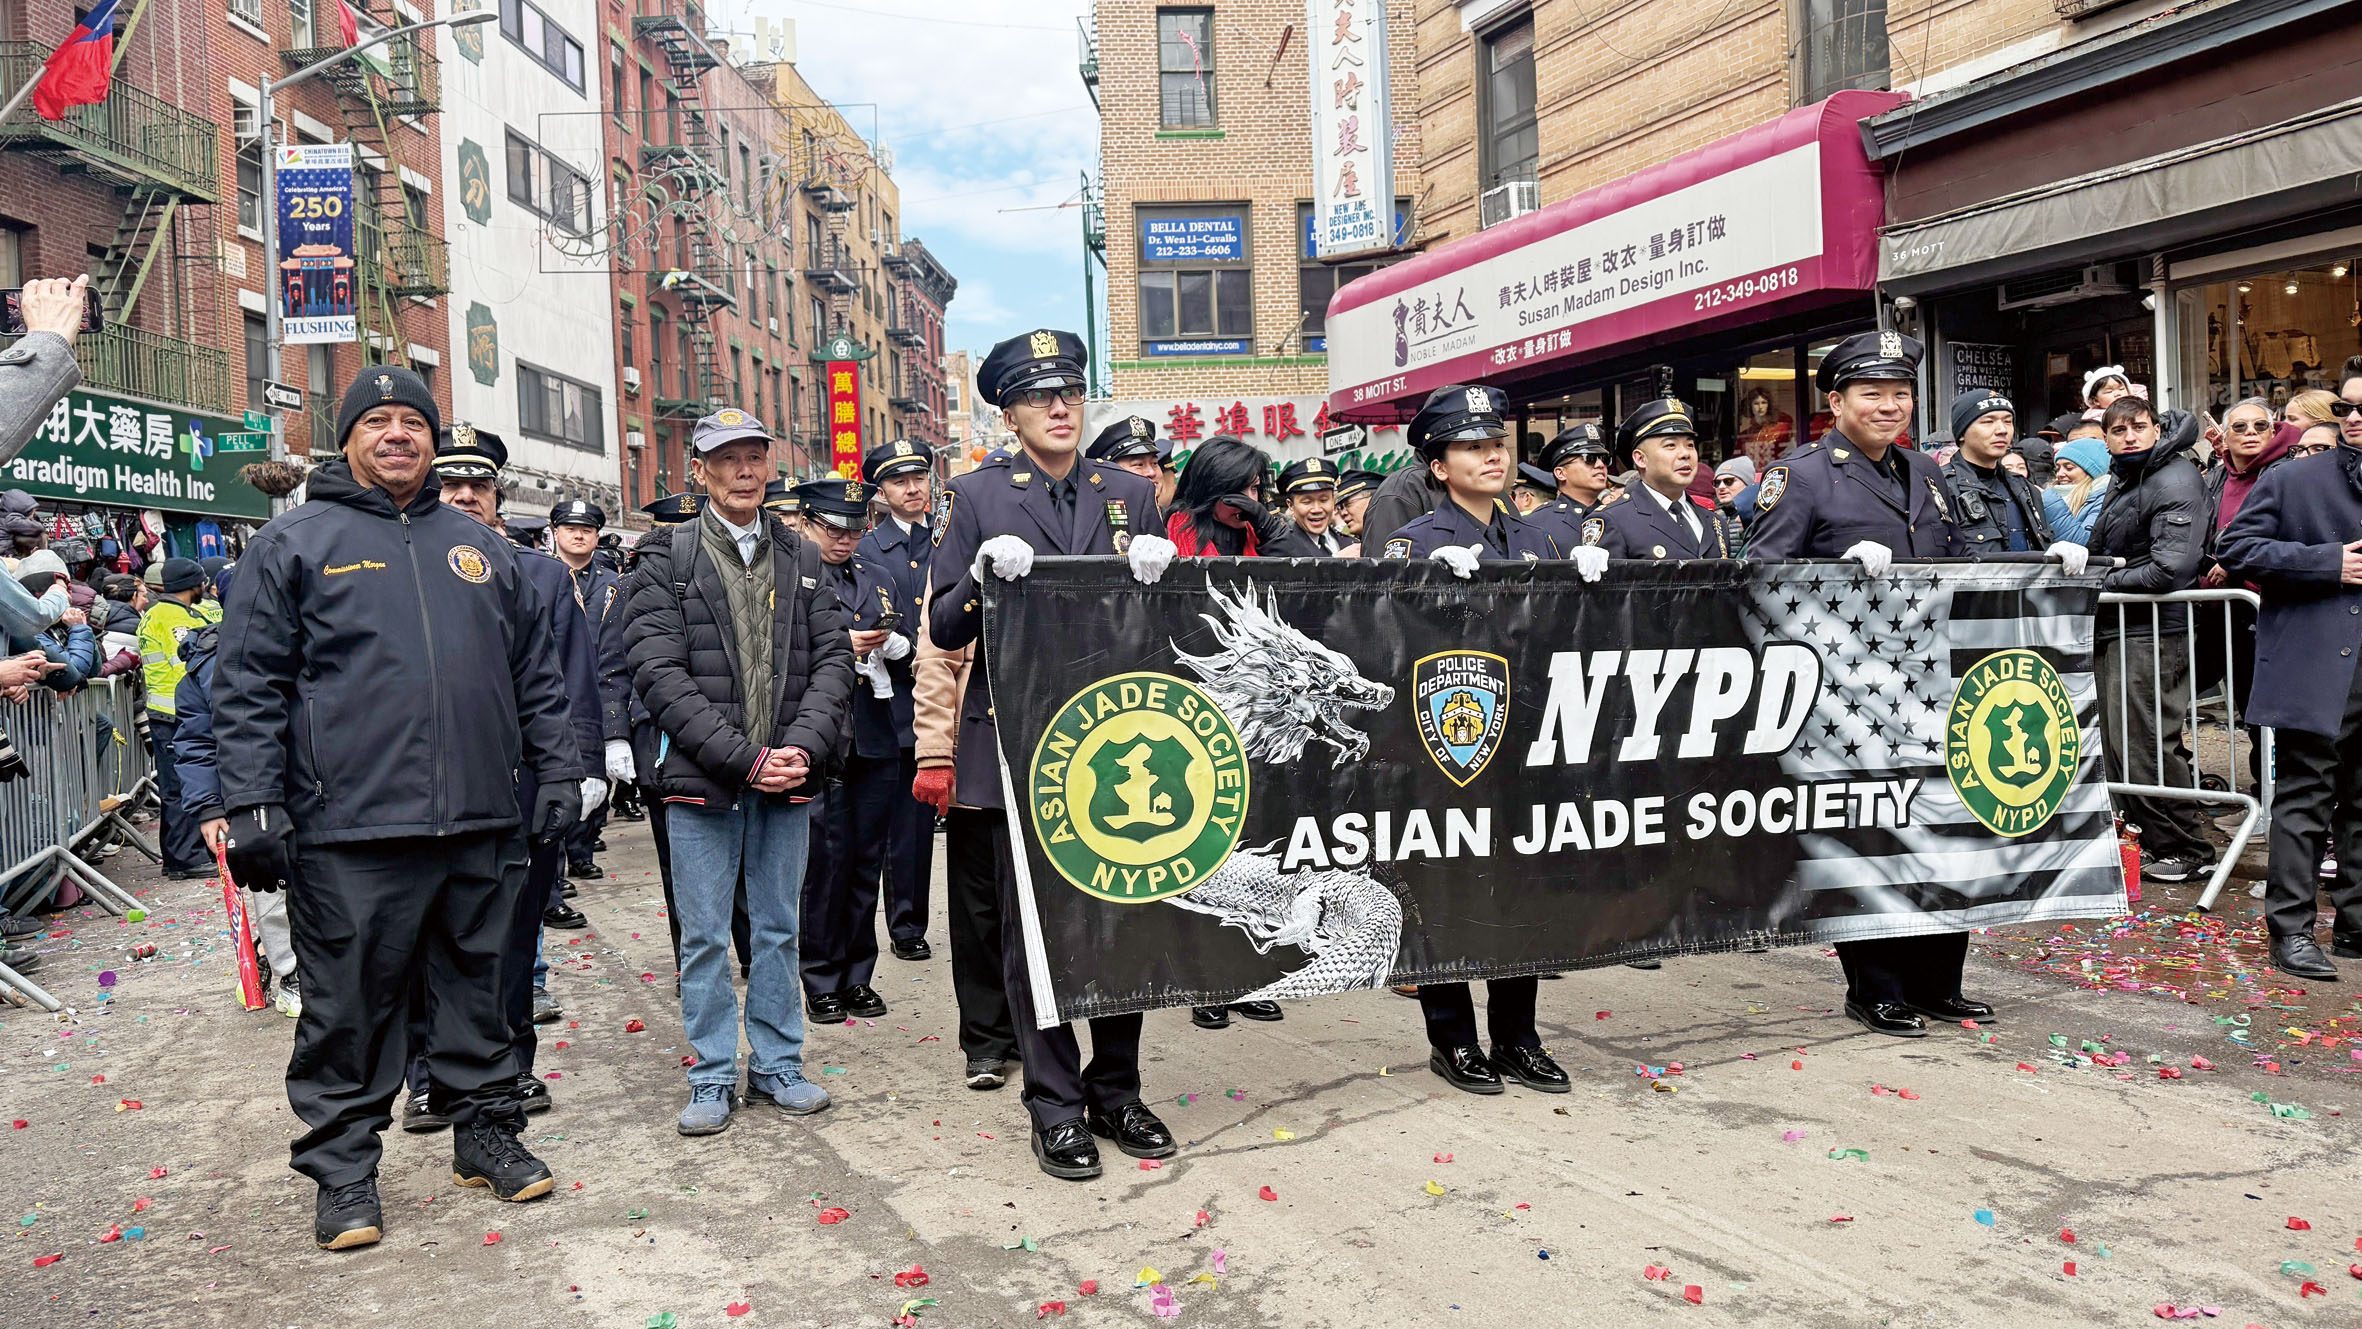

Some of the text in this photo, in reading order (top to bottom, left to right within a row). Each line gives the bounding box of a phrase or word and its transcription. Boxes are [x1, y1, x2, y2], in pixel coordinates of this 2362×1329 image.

[1331, 0, 1368, 199] 夫人時裝屋
[290, 196, 343, 218] 250
[1334, 204, 1349, 215] NEW
[302, 222, 331, 231] Years
[1150, 221, 1235, 233] BELLA DENTAL
[1329, 210, 1376, 228] DESIGNER INC.
[1148, 235, 1162, 244] Dr.
[1165, 235, 1186, 244] Wen
[1330, 222, 1375, 243] 349-0818
[1156, 245, 1231, 256] 212-233-6606
[1892, 242, 1945, 261] 36 MOTT
[1518, 257, 1710, 327] Susan Madam Design Inc.
[1694, 266, 1799, 312] 212-349-0818
[1408, 286, 1476, 337] 貴夫人
[285, 320, 355, 334] FLUSHING
[1410, 334, 1476, 363] NOBLE MADAM
[1957, 350, 2012, 366] CHELSEA
[1353, 376, 1408, 402] 38 MOTT ST.
[1957, 373, 2012, 387] GRAMERCY
[269, 389, 298, 403] ONE WAY
[226, 435, 249, 445] PELL
[1329, 430, 1361, 448] ONE WAY
[114, 464, 182, 498] Health
[186, 473, 215, 502] Inc
[1437, 656, 1487, 674] POLICE
[1418, 672, 1505, 699] DEPARTMENT
[1526, 644, 1820, 767] NYPD
[1950, 657, 2077, 789] ASIAN JADE SOCIETY
[1420, 703, 1505, 772] CITY OF NEW YORK
[1038, 682, 1241, 844] ASIAN JADE SOCIETY
[1282, 778, 1921, 870] ASIAN JADE SOCIETY
[1992, 798, 2048, 831] NYPD
[1090, 856, 1196, 895] NYPD
